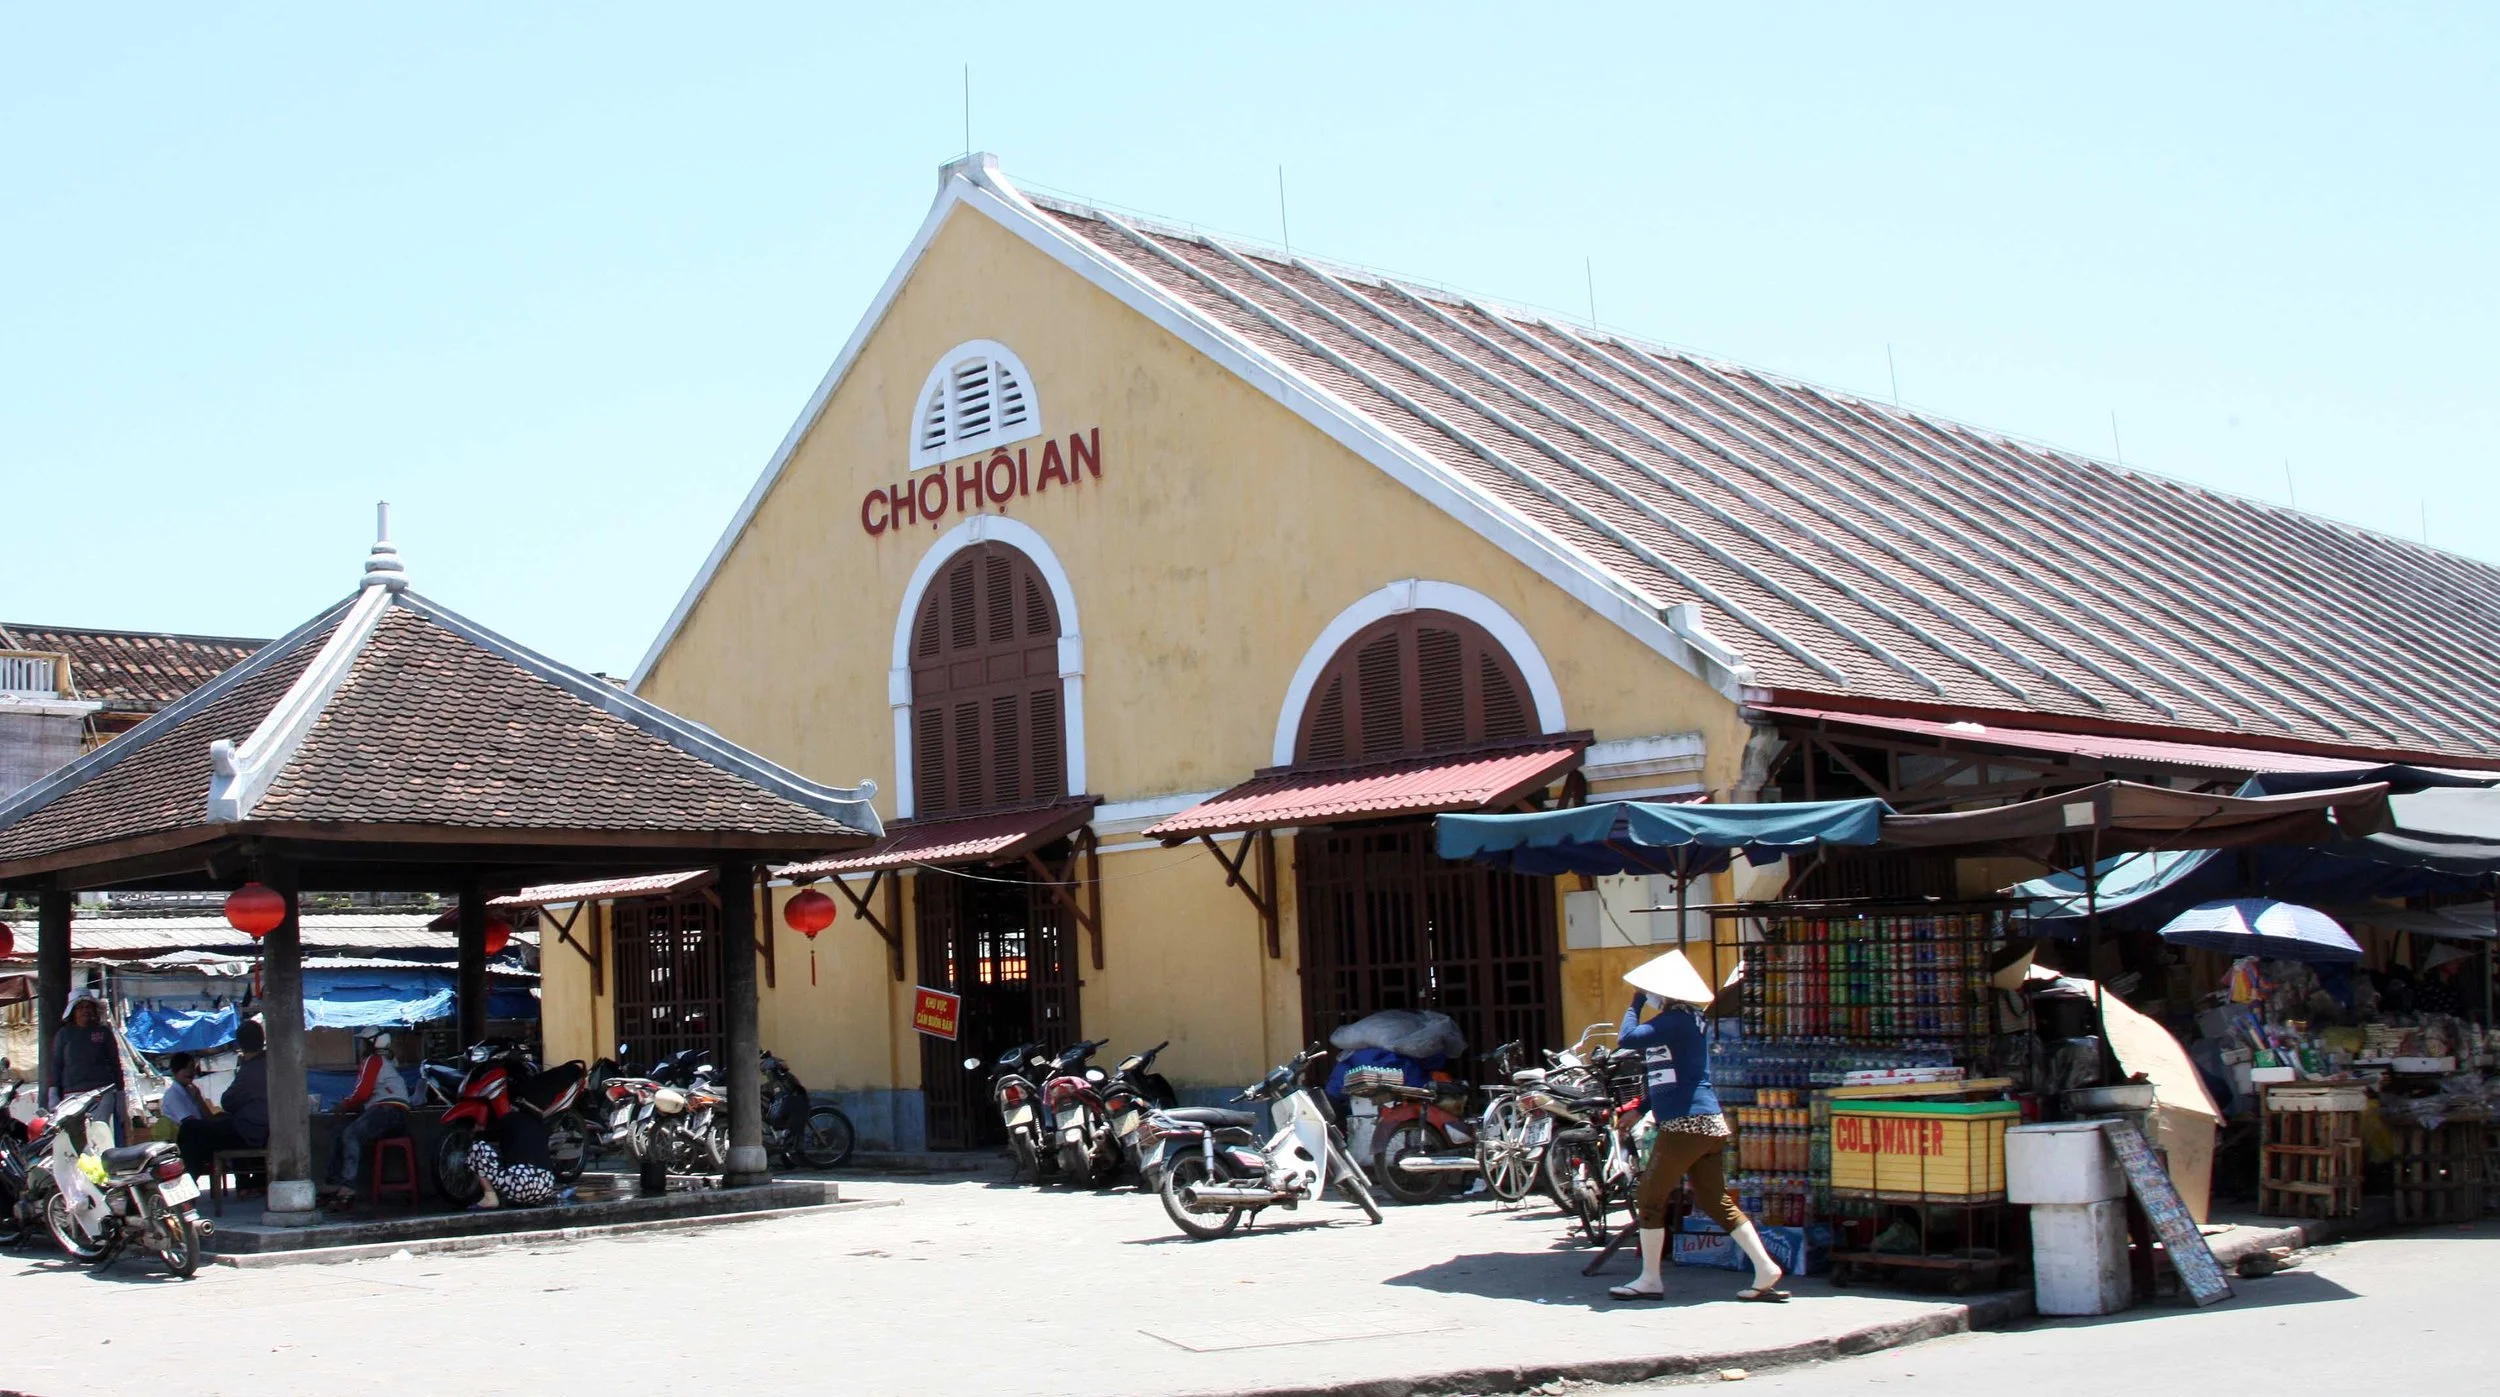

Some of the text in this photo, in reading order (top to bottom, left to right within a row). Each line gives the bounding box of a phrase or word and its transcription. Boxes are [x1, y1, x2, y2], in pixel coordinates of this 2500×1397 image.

[861, 426, 1102, 536] CHỢ HỘI AN
